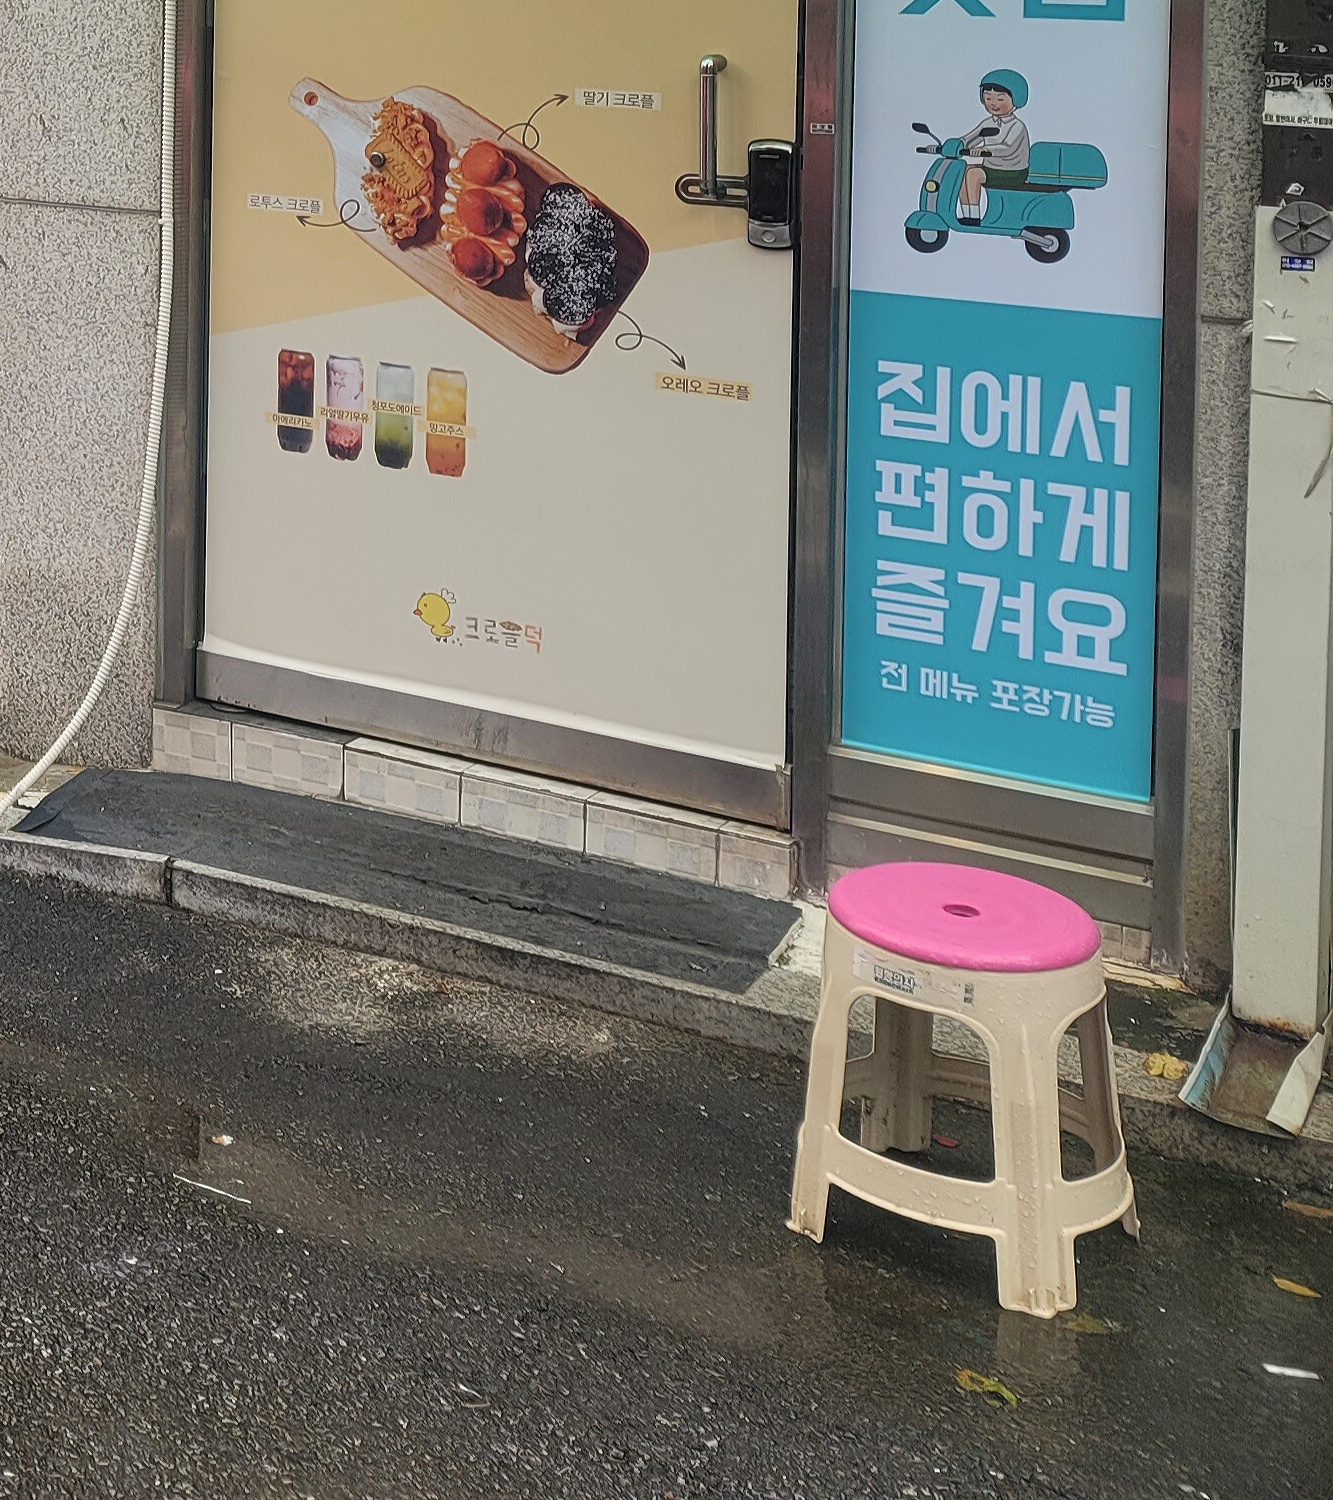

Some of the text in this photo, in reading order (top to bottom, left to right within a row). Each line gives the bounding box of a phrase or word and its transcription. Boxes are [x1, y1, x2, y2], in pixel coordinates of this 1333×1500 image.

[583, 90, 654, 110] 딸기 크로플
[249, 194, 321, 214] 로투스 크로플
[660, 376, 750, 401] 오레오 크로플
[319, 407, 370, 423] 리얼딸기우유
[371, 400, 422, 416] 청포도에이드
[876, 359, 1132, 467] 집에서
[272, 414, 313, 428] 아메리카노
[429, 422, 465, 436] 망고주스
[874, 458, 1130, 572] 편하게
[870, 558, 1128, 678] 즐겨요
[880, 660, 1117, 730] 전 메뉴 포장가능
